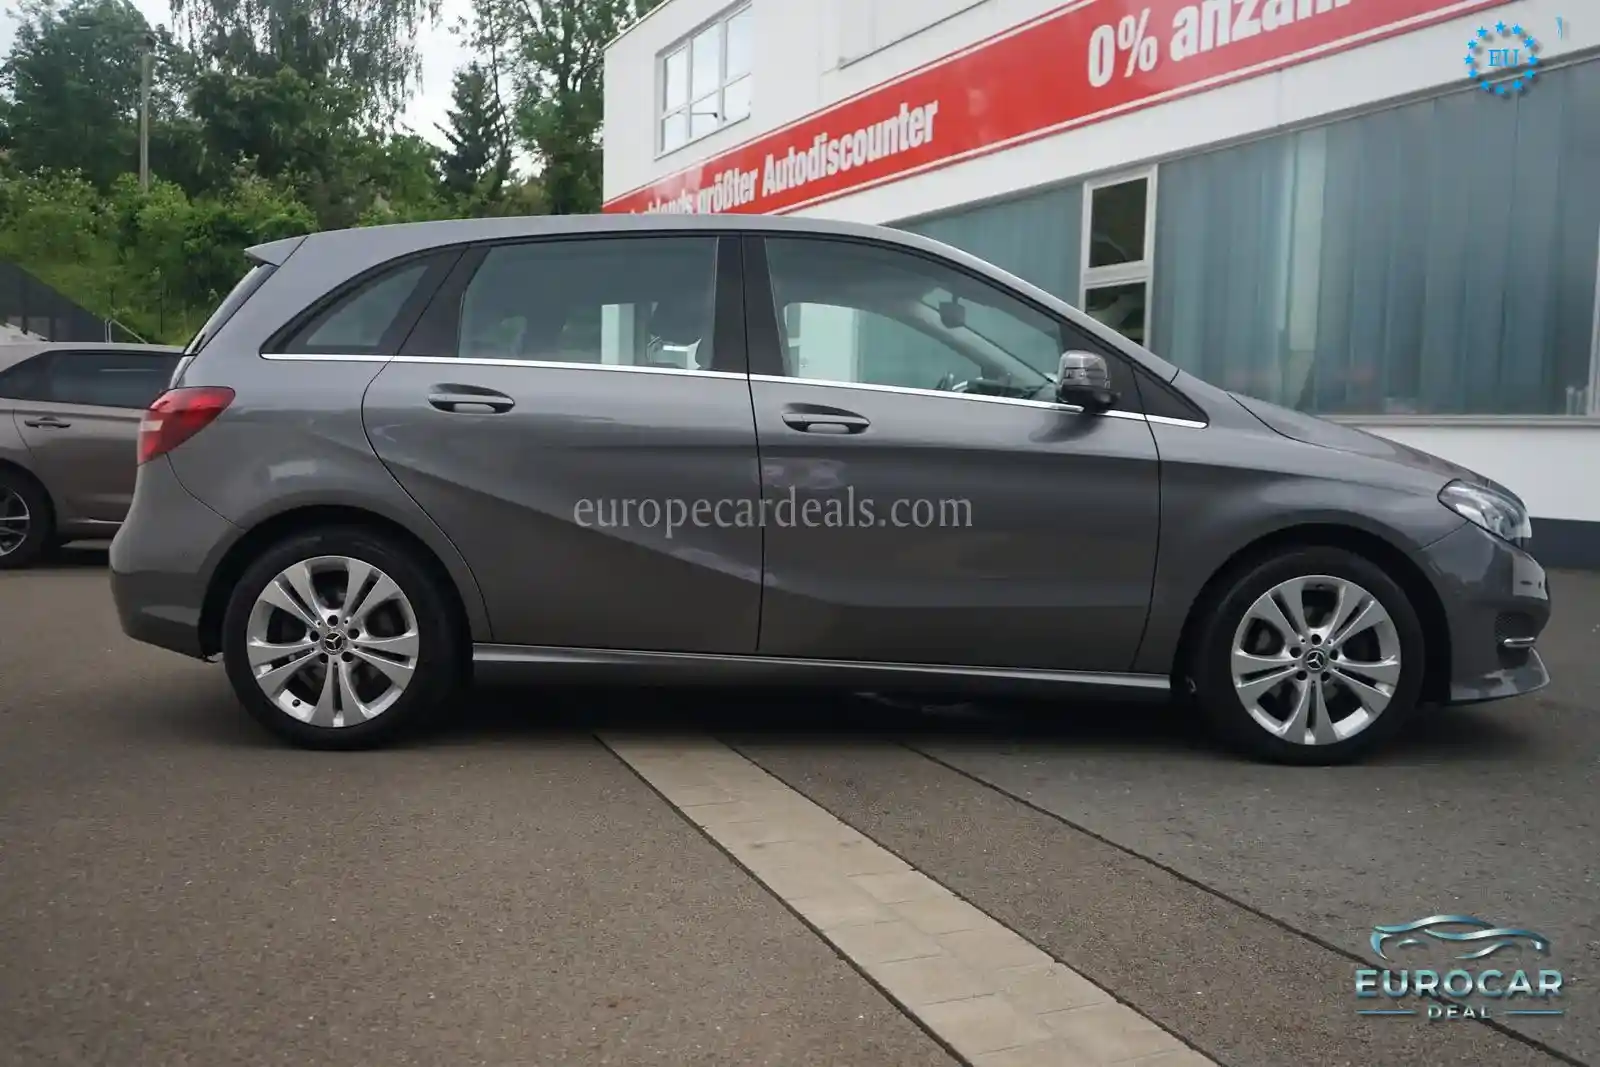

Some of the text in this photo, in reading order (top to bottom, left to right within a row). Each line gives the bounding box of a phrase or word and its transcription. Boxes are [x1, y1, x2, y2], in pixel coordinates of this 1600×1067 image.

[1088, 0, 1351, 88] 0% anza
[762, 100, 938, 197] Autodiscounter
